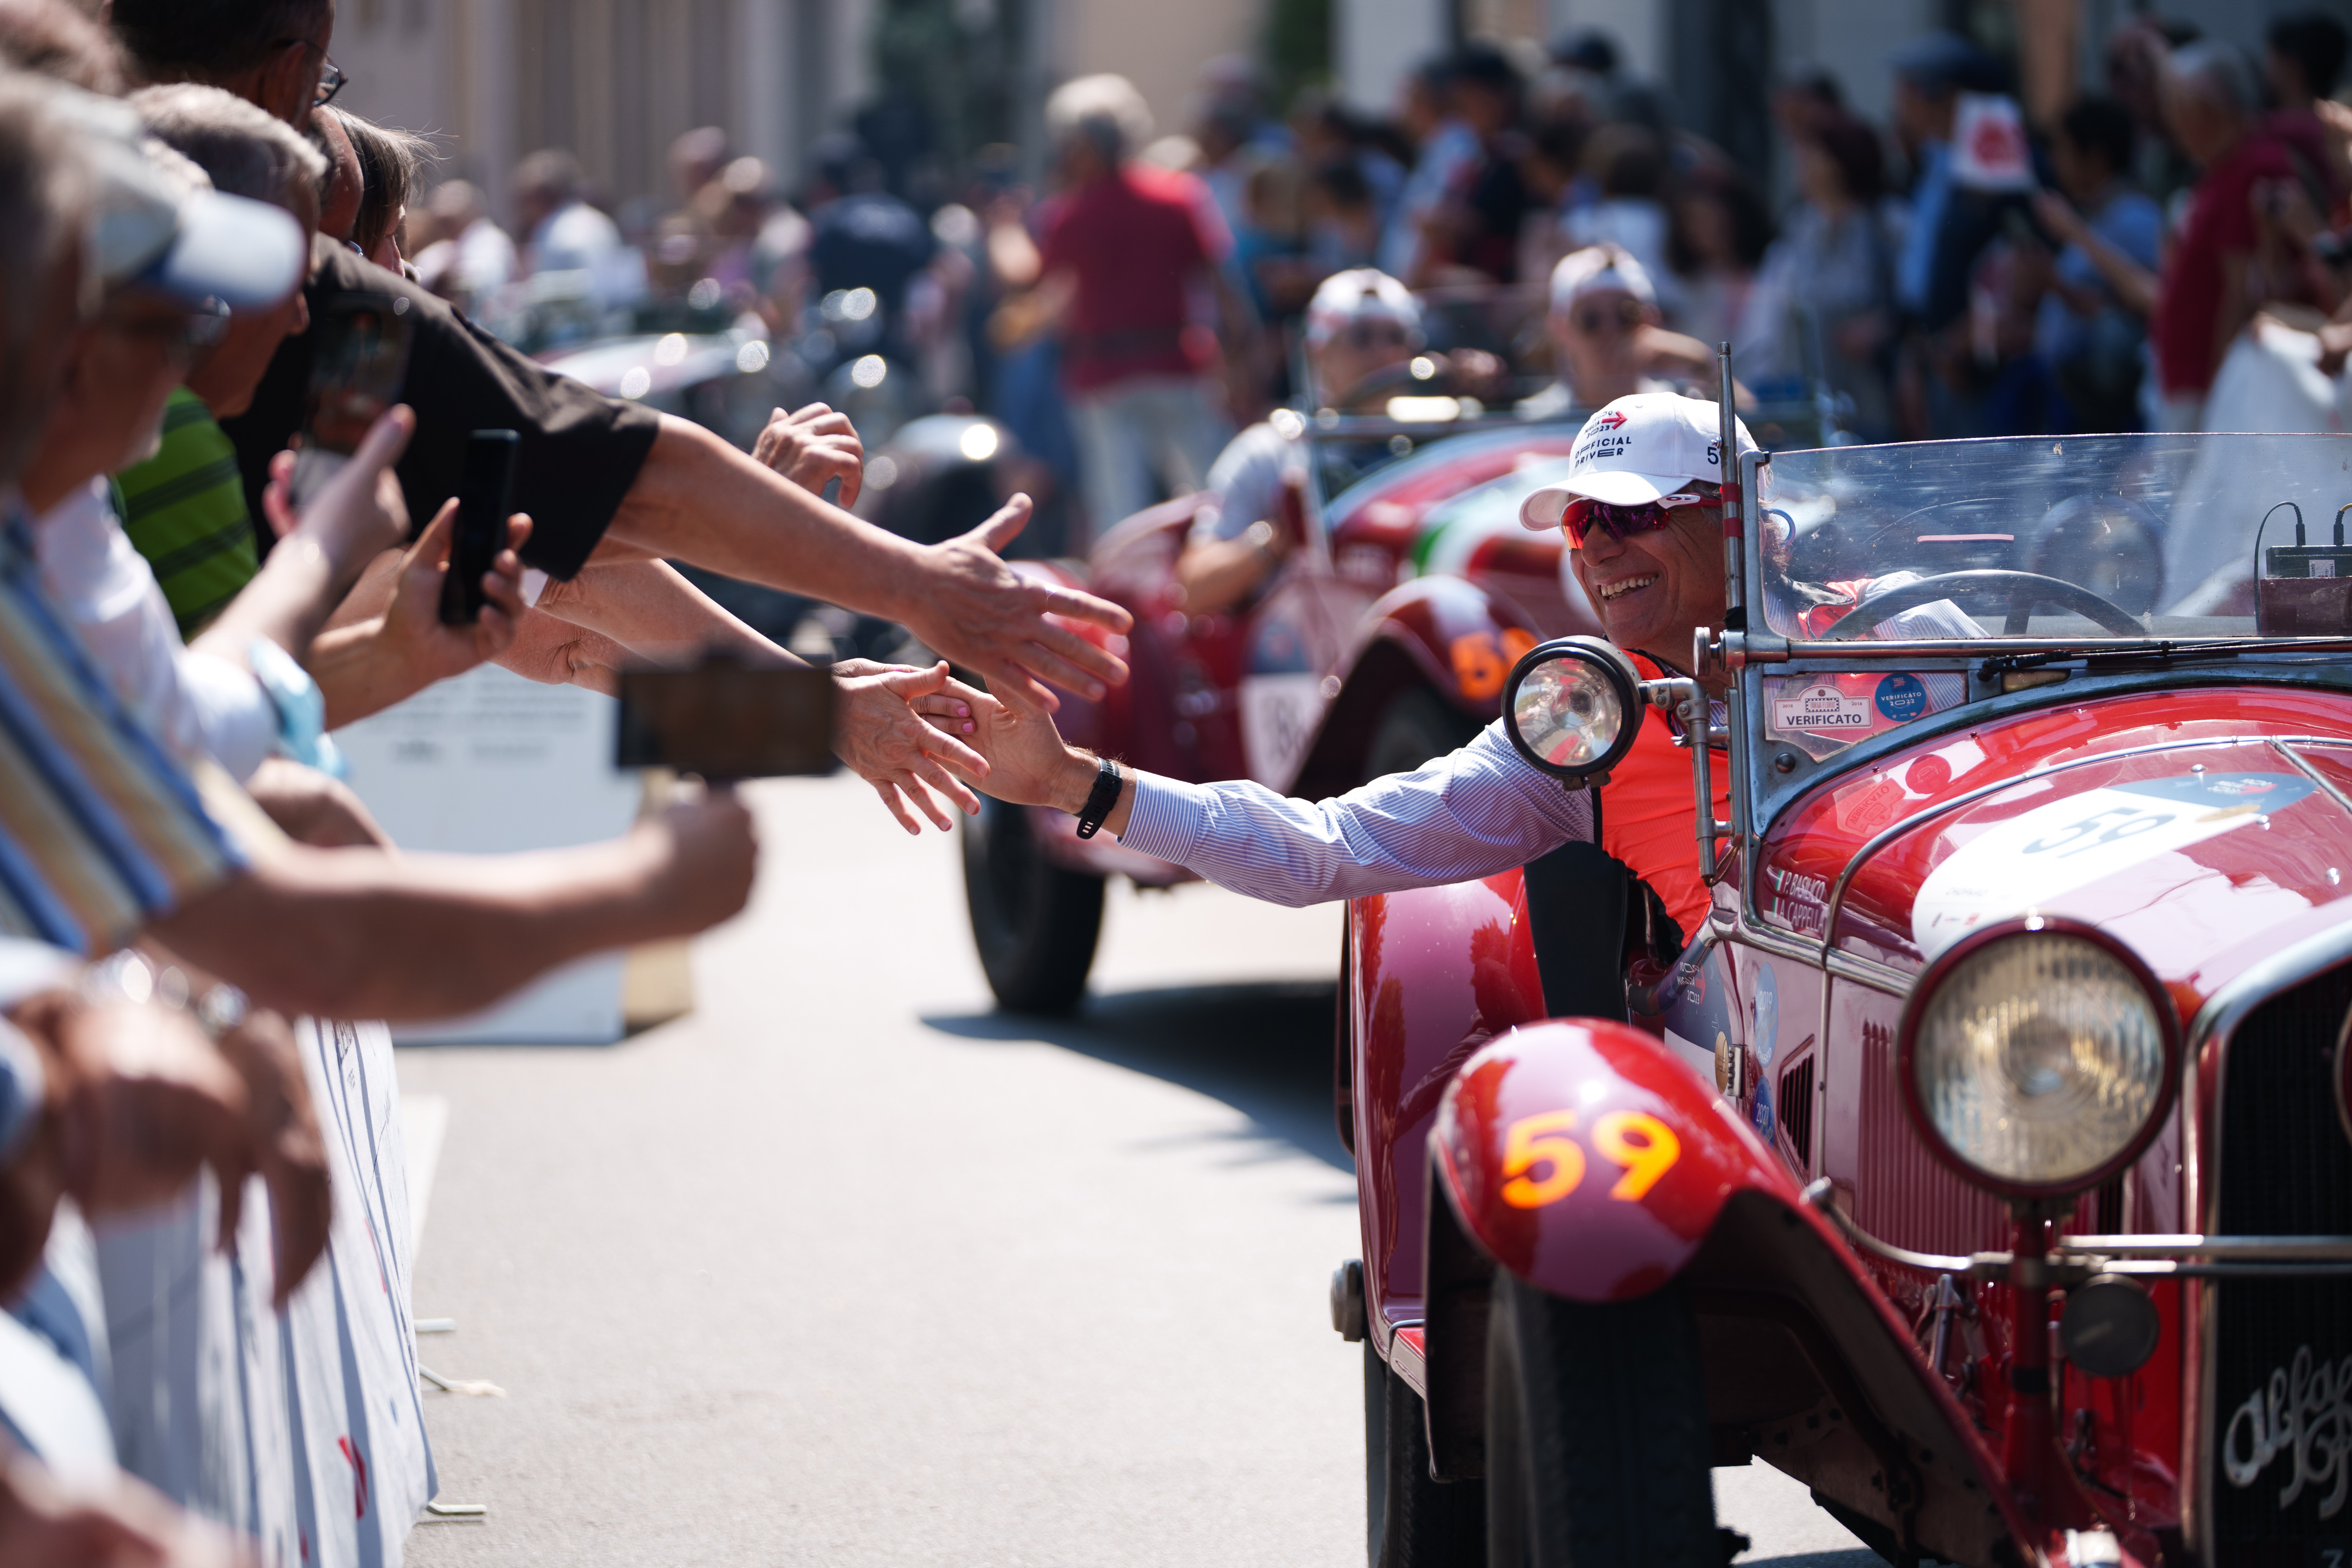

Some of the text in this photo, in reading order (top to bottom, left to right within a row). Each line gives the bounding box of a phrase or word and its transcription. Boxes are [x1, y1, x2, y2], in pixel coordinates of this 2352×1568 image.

[1587, 424, 1611, 439] 2023
[1575, 436, 1632, 459] OFFICIAL
[1575, 447, 1624, 468] DRIVER
[1880, 692, 1922, 701] VERIFICATO
[1786, 714, 1862, 726] VERIFICATO
[1687, 989, 1700, 1005] 2023
[1759, 990, 1773, 1011] 2019
[1756, 1102, 1769, 1124] 2021
[1501, 1108, 1681, 1210] 59
